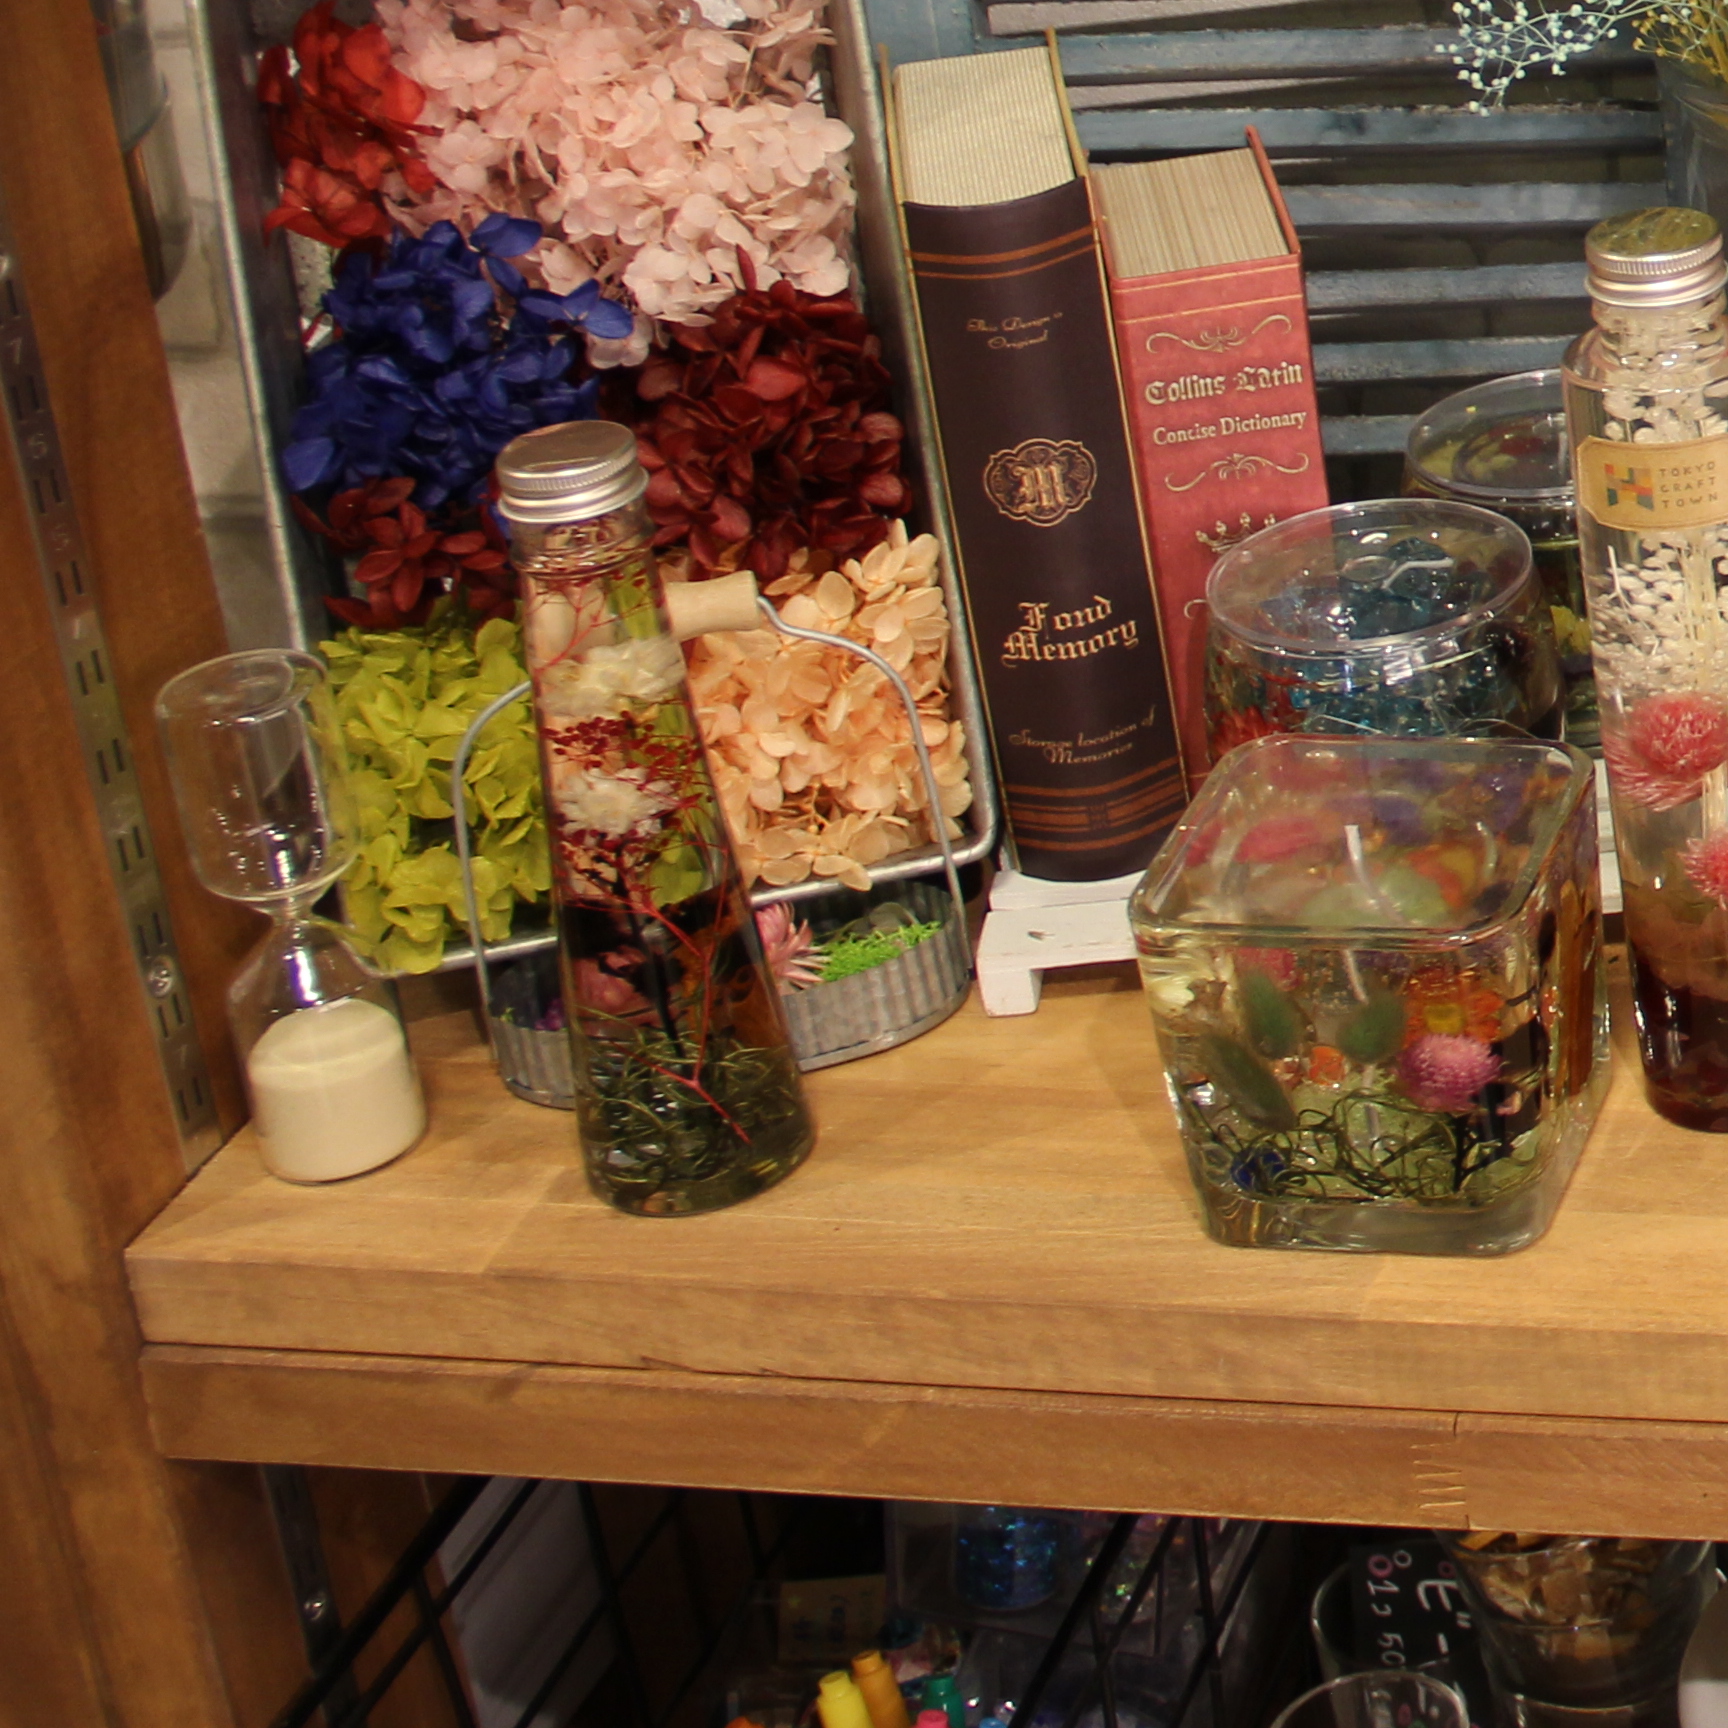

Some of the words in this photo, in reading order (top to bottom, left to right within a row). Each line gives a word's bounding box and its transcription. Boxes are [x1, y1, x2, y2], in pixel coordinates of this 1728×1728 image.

[1145, 374, 1226, 405] Collins
[1233, 361, 1304, 392] Latin
[1153, 423, 1217, 445] Concise
[1219, 413, 1307, 436] Dictionary
[1659, 461, 1716, 478] TOKYO
[1660, 476, 1717, 493] CRAFT
[1662, 492, 1718, 509] TOWN
[1018, 595, 1112, 634] Fond
[1000, 620, 1139, 668] Memory
[1044, 742, 1133, 764] Memories
